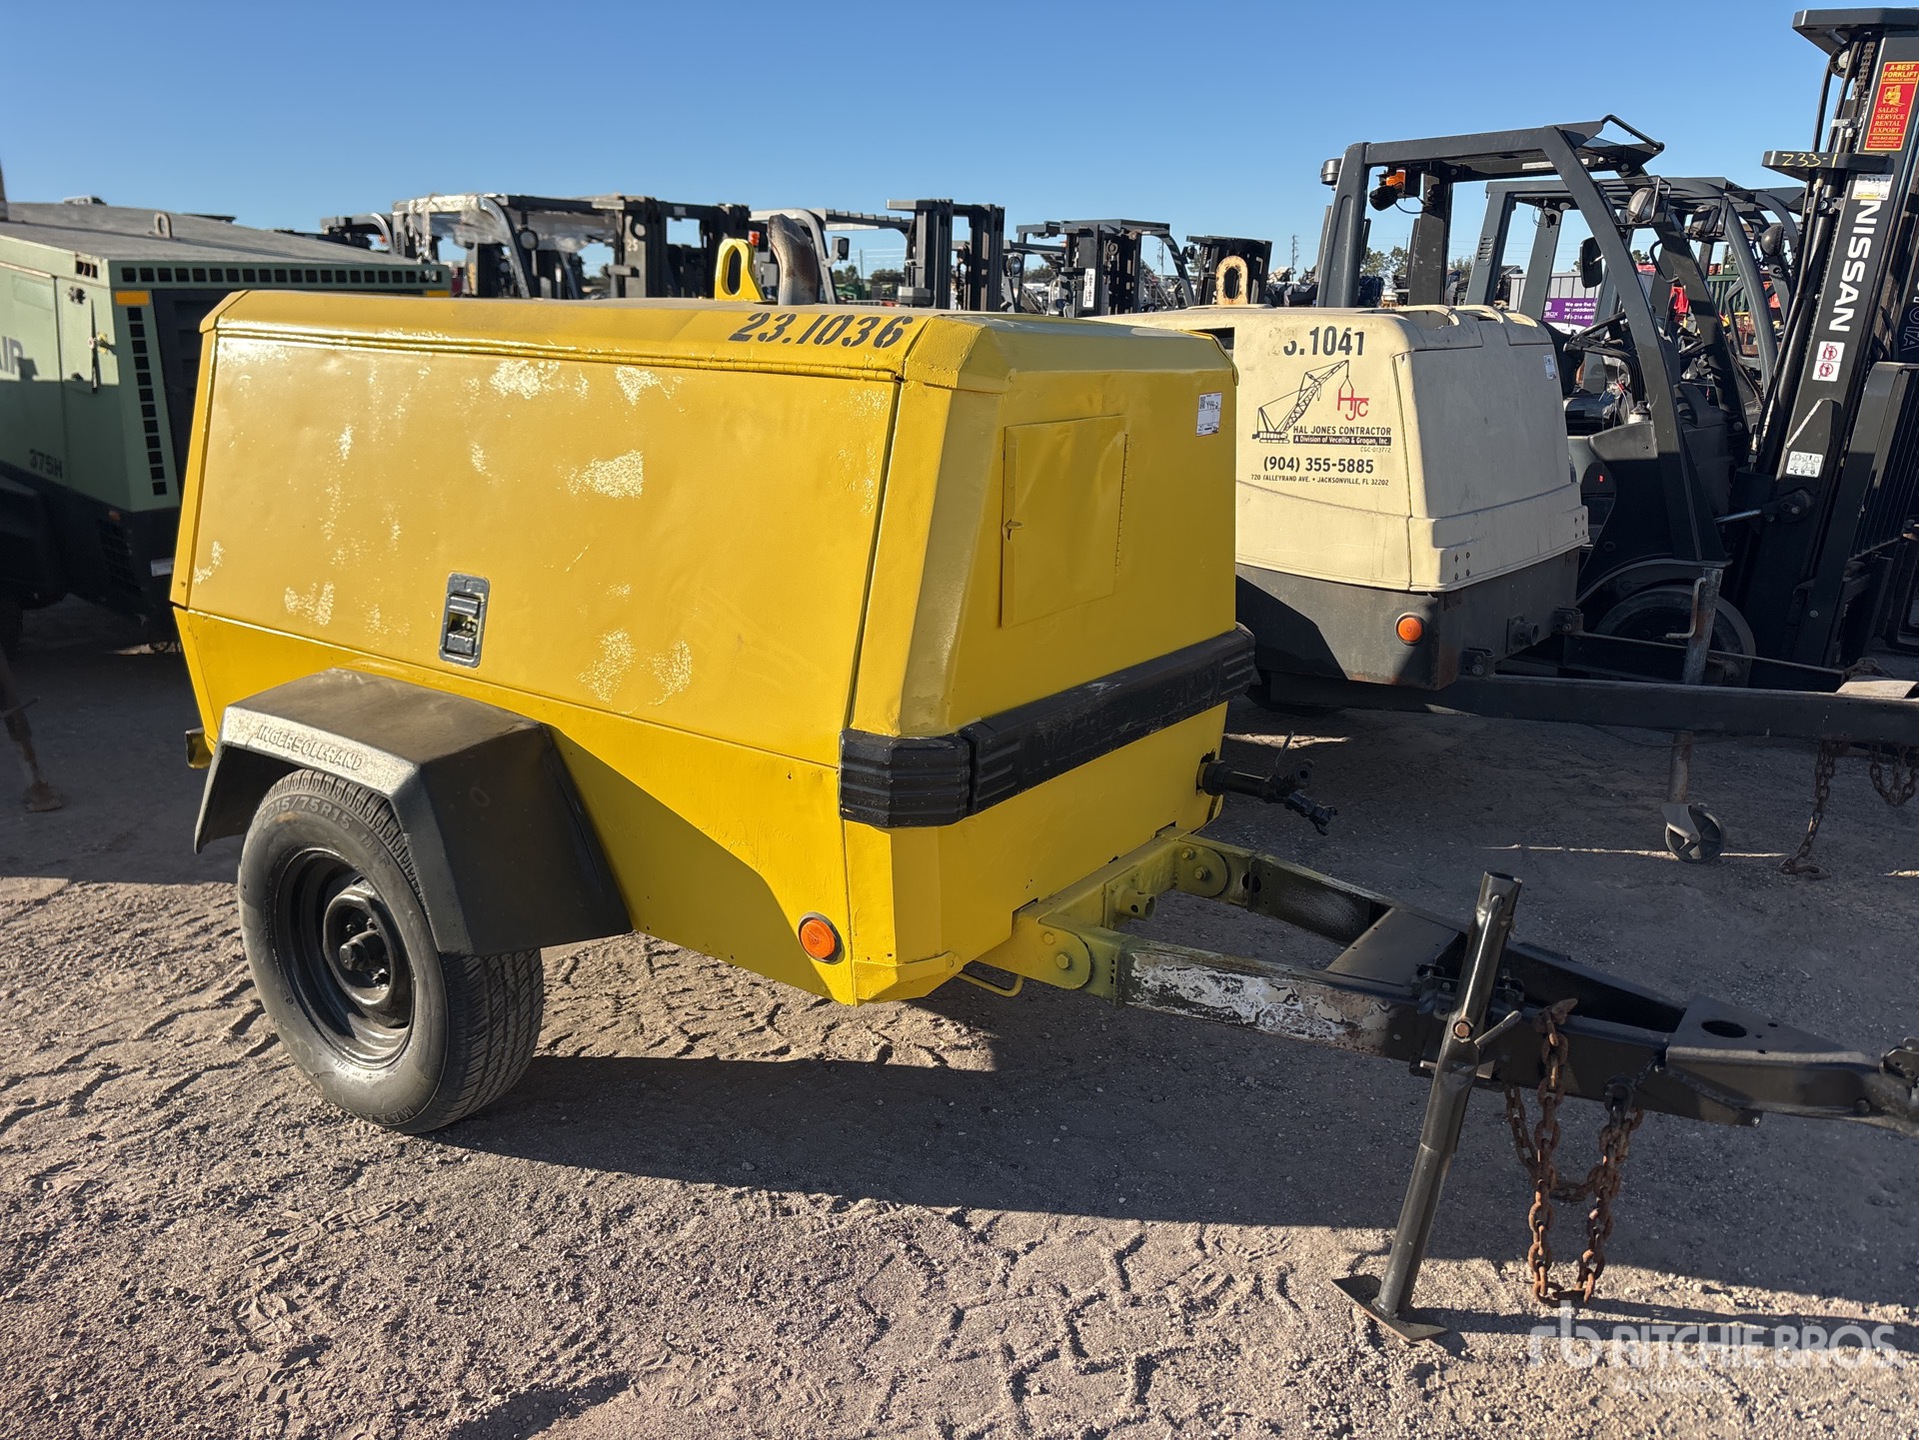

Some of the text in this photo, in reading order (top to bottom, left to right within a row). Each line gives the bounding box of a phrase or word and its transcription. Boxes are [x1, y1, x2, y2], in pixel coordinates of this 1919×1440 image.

[1828, 200, 1882, 332] NISSAN
[728, 312, 914, 348] 23.1036
[1293, 426, 1392, 436] HAL JONES CONTRACTOR
[30, 448, 63, 478] 375H
[1264, 456, 1374, 474] (904) 355-5885
[1317, 476, 1360, 485] JACKSONVILLE,
